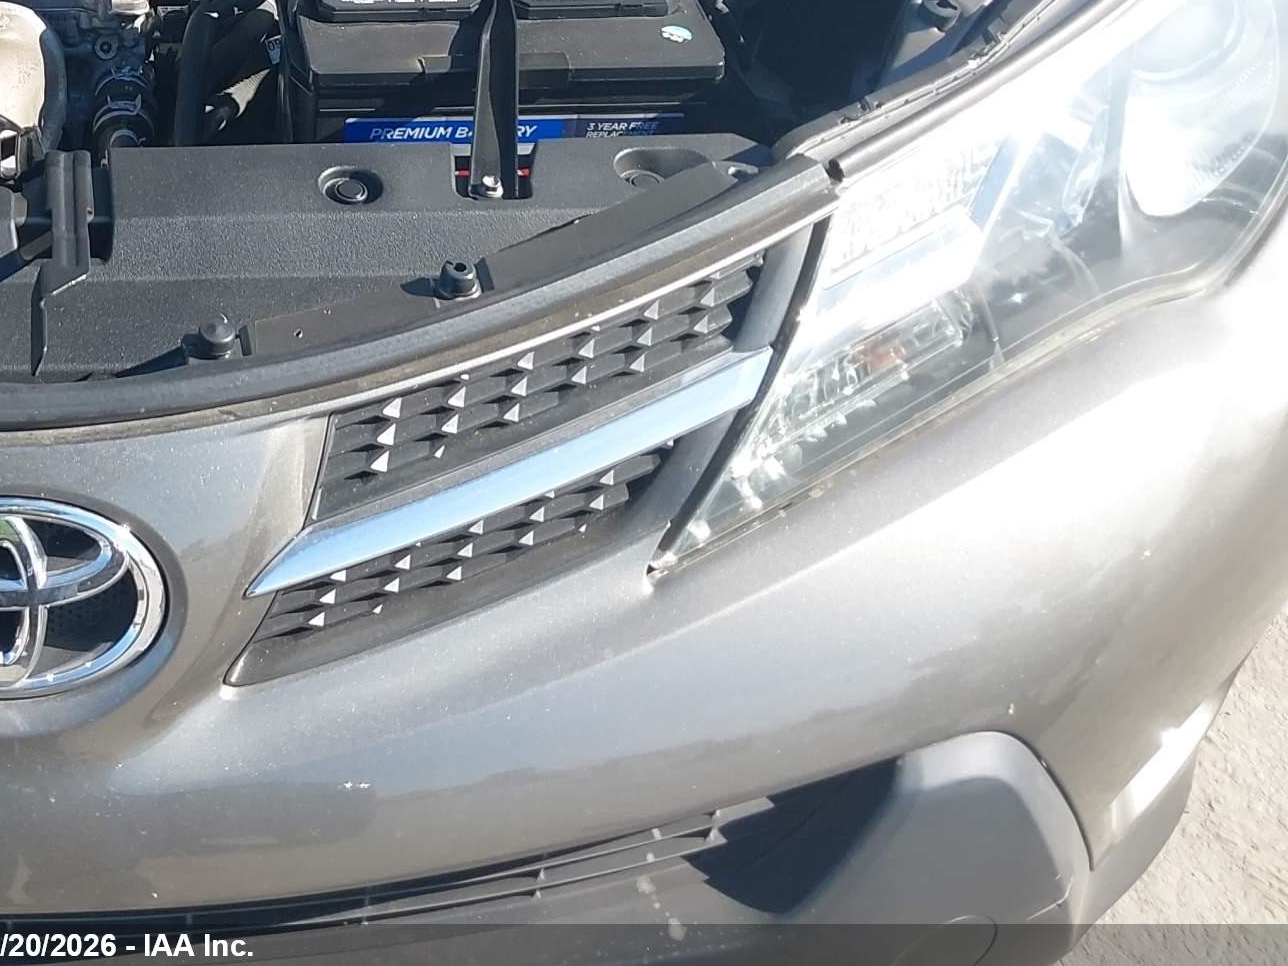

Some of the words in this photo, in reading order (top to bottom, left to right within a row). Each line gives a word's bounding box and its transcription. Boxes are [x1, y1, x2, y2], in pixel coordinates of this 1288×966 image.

[586, 122, 596, 131] 3
[597, 122, 628, 131] YEAR
[628, 121, 660, 131] FREE
[369, 126, 452, 140] PREMIUM
